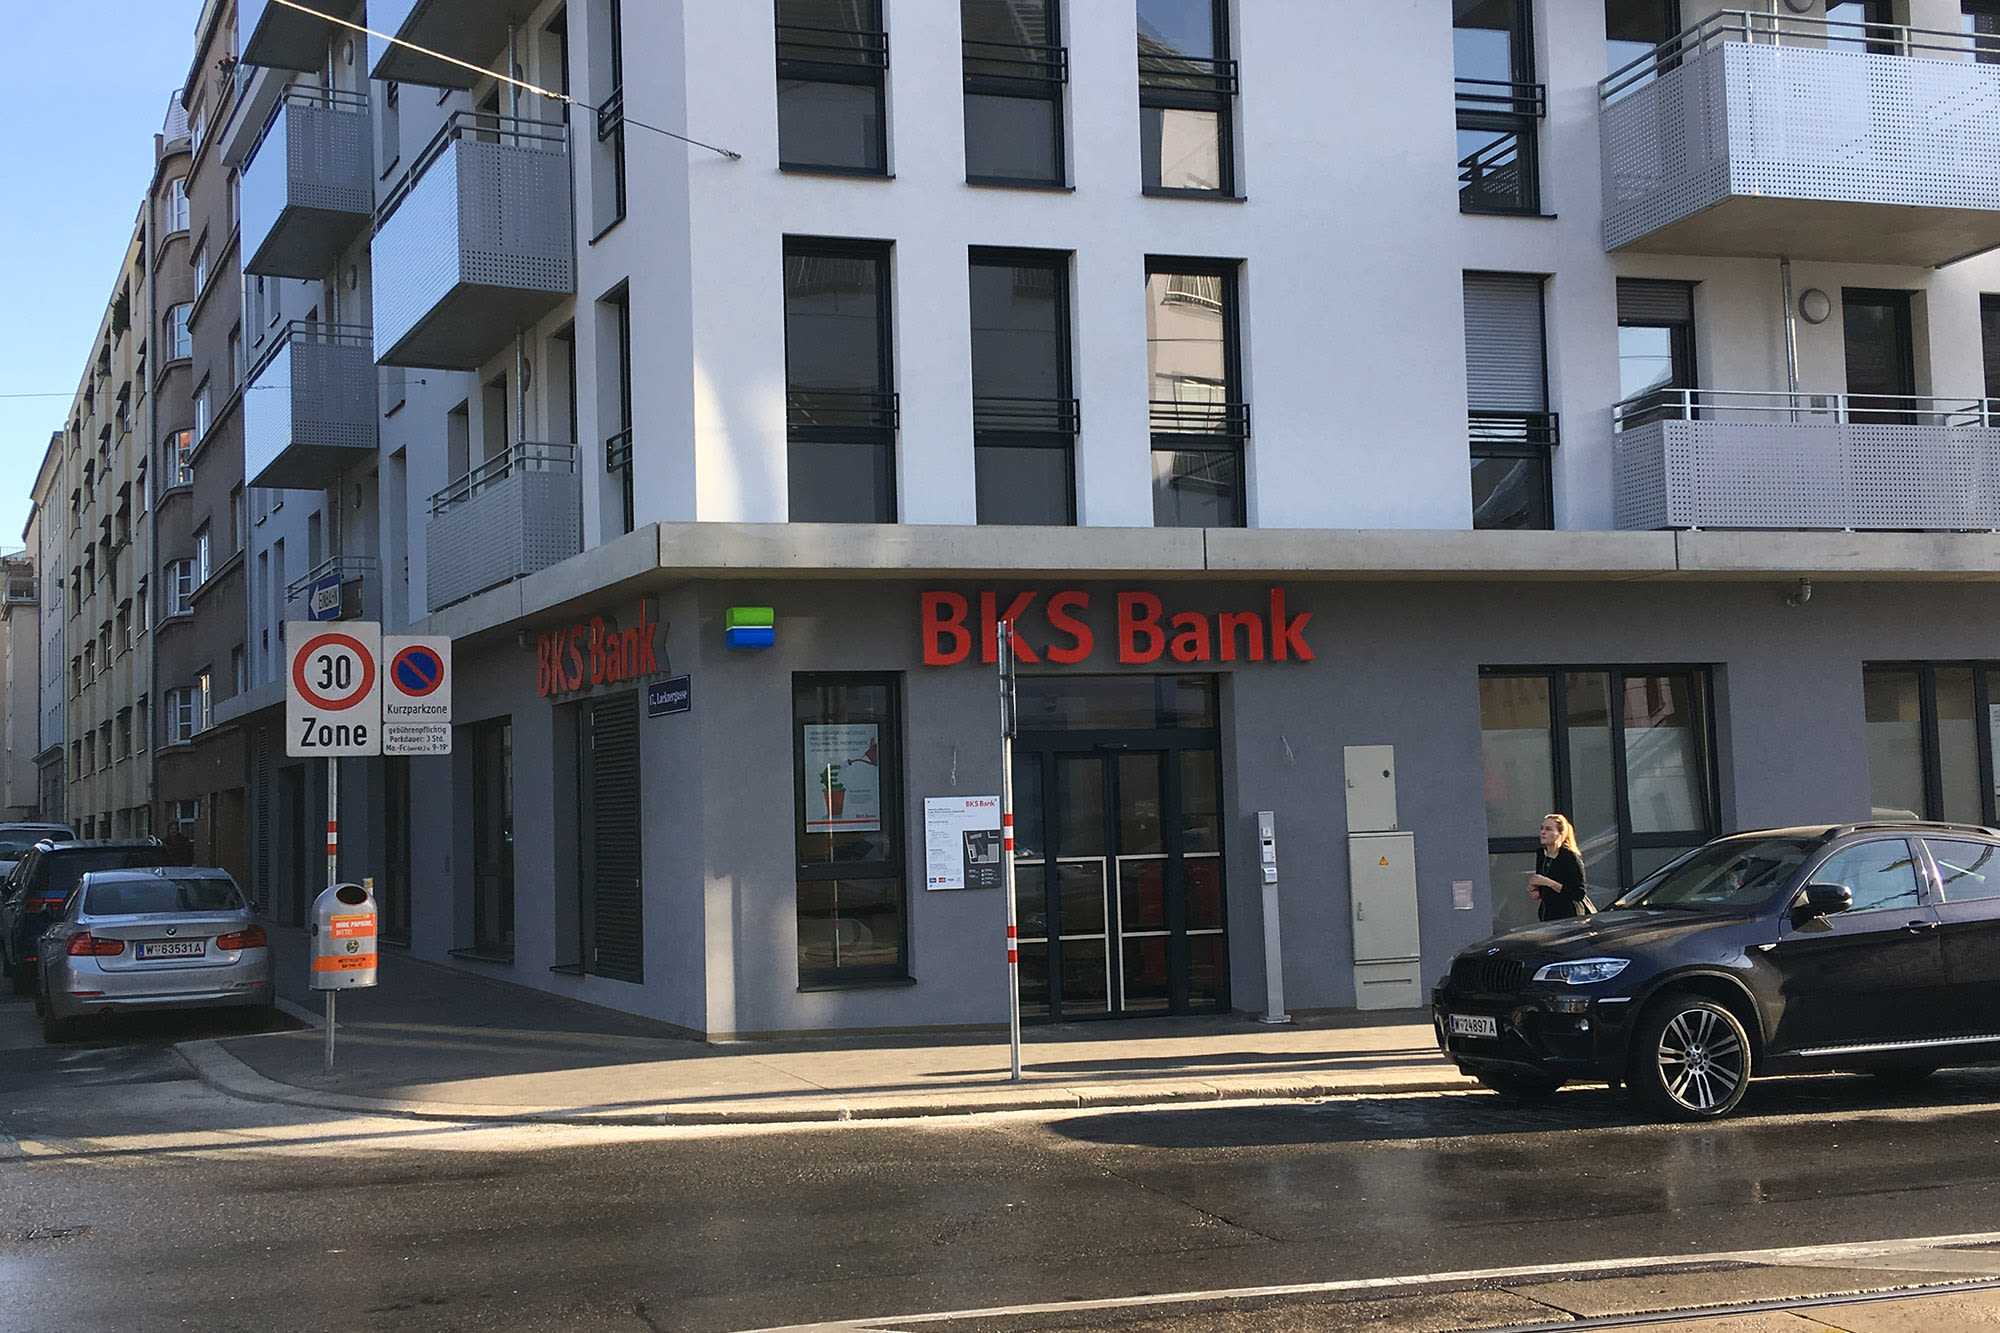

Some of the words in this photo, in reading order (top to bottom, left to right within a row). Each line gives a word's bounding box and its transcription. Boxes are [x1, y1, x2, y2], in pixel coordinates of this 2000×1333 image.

[921, 591, 1094, 666] BKS
[1118, 588, 1316, 664] Bank
[537, 624, 584, 699] BKS
[590, 599, 659, 685] Bank
[317, 654, 351, 690] 30
[387, 704, 448, 716] Kurzparkzone
[301, 717, 367, 747] Zone
[388, 726, 447, 735] gebührenpflichtig
[426, 735, 431, 743] 3
[432, 735, 445, 743] Std.
